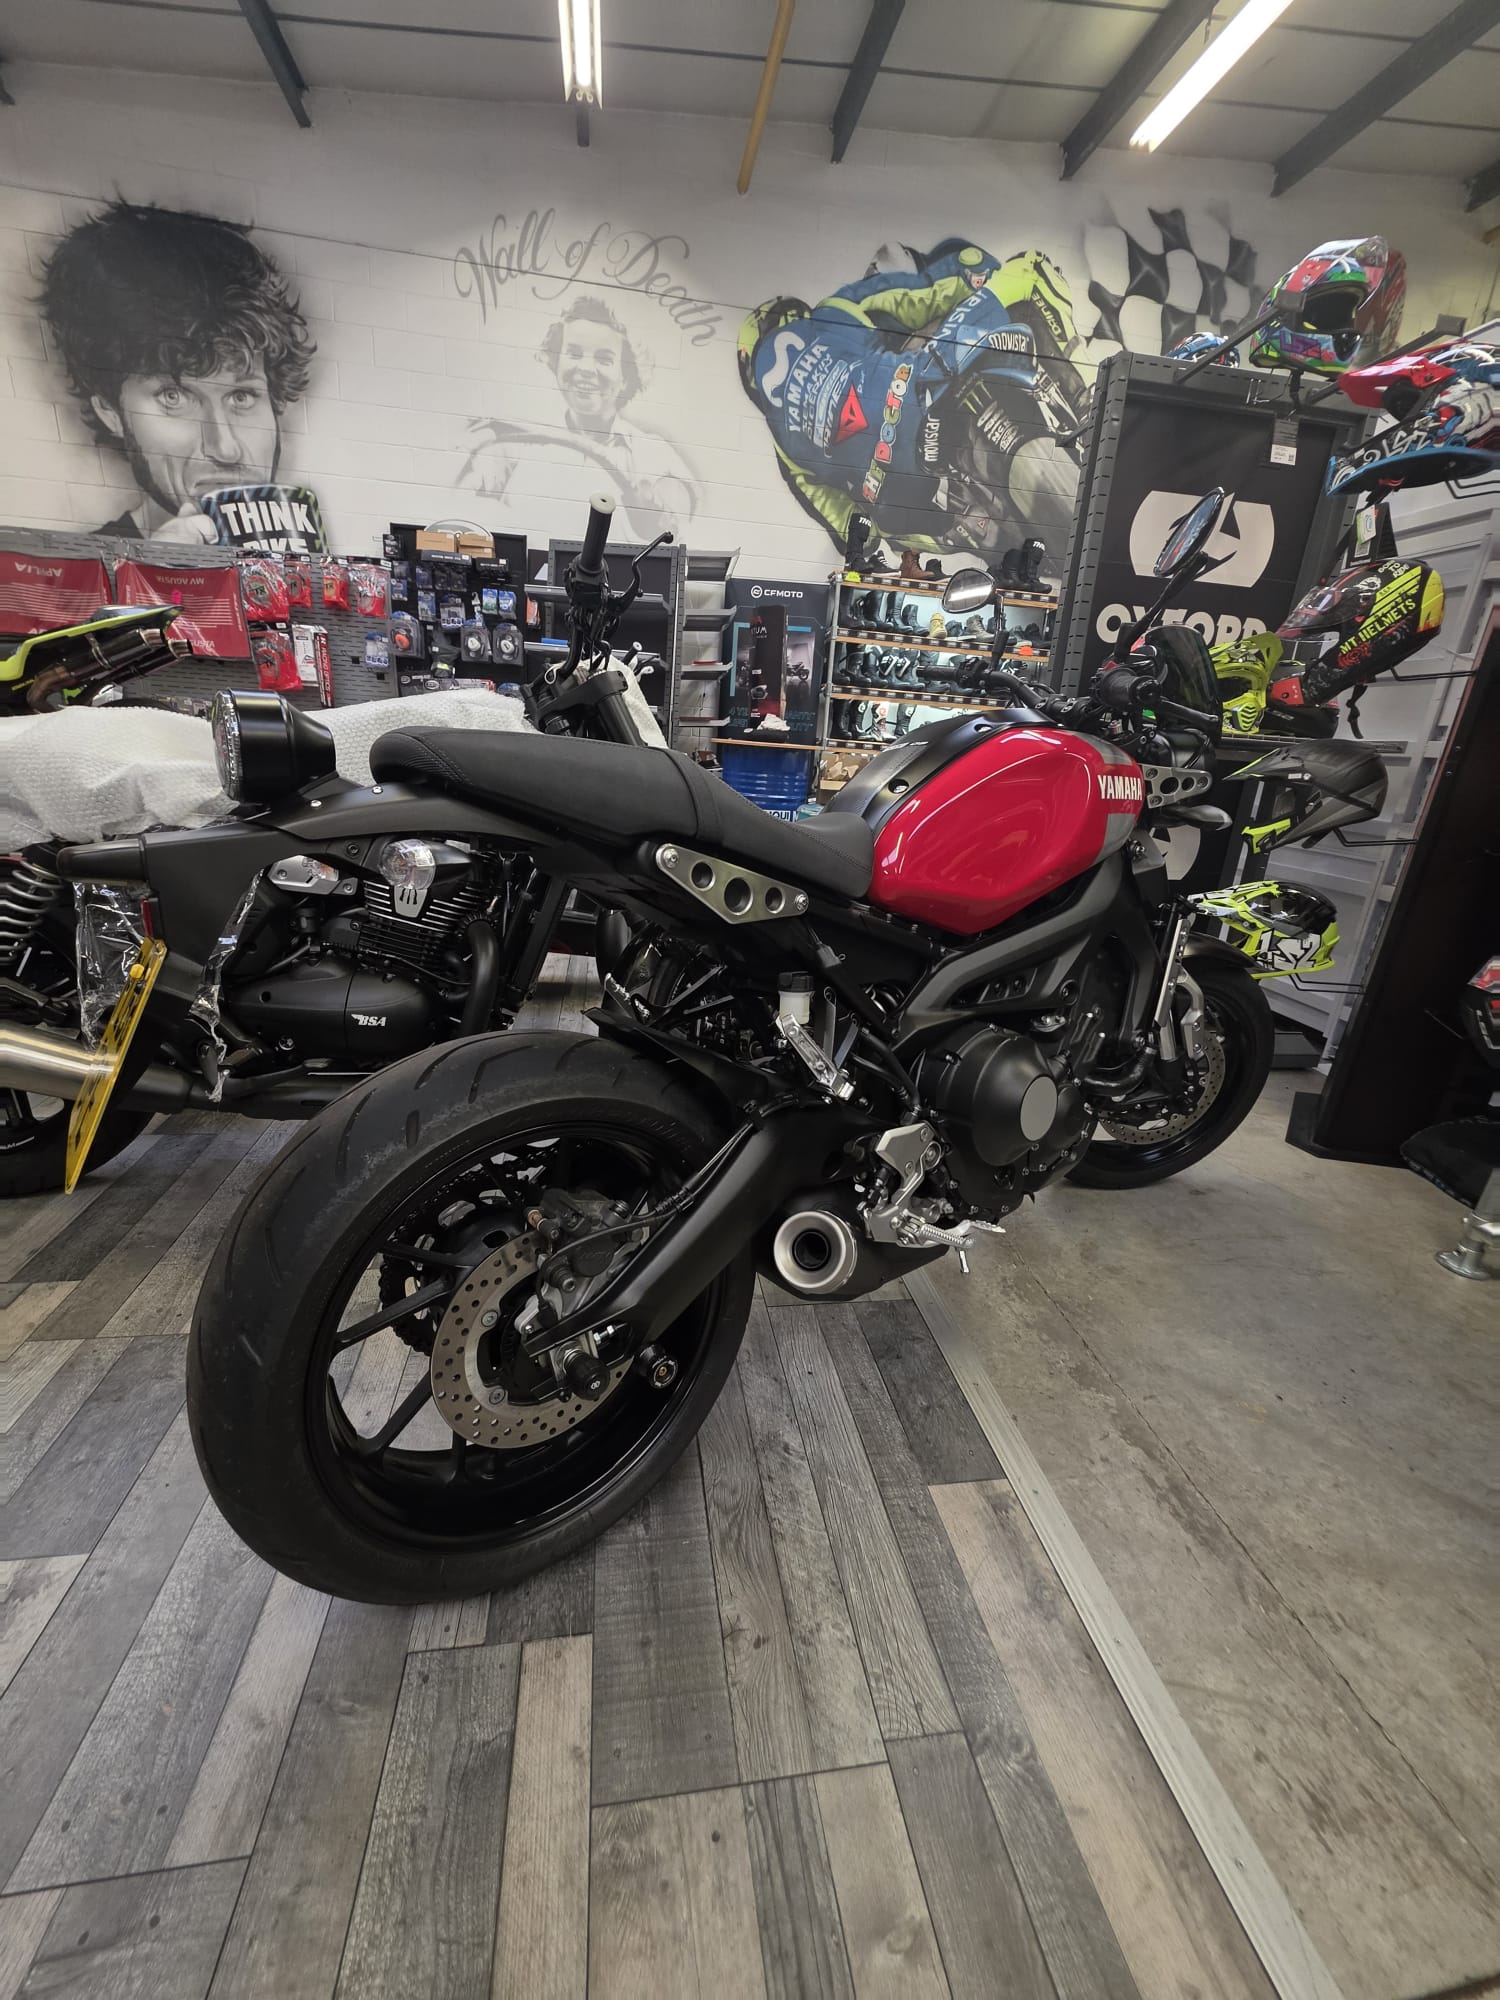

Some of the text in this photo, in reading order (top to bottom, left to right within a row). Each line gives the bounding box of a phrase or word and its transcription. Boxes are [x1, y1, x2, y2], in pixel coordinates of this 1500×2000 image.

[454, 207, 723, 346] Wall of Death
[787, 344, 829, 433] YAMAHA
[923, 413, 941, 462] movistar
[220, 500, 317, 536] THINK
[763, 589, 804, 599] CFMOTO
[1339, 598, 1417, 655] MT HELMETS
[1097, 774, 1143, 801] YAMAHA
[351, 1013, 387, 1027] BSA
